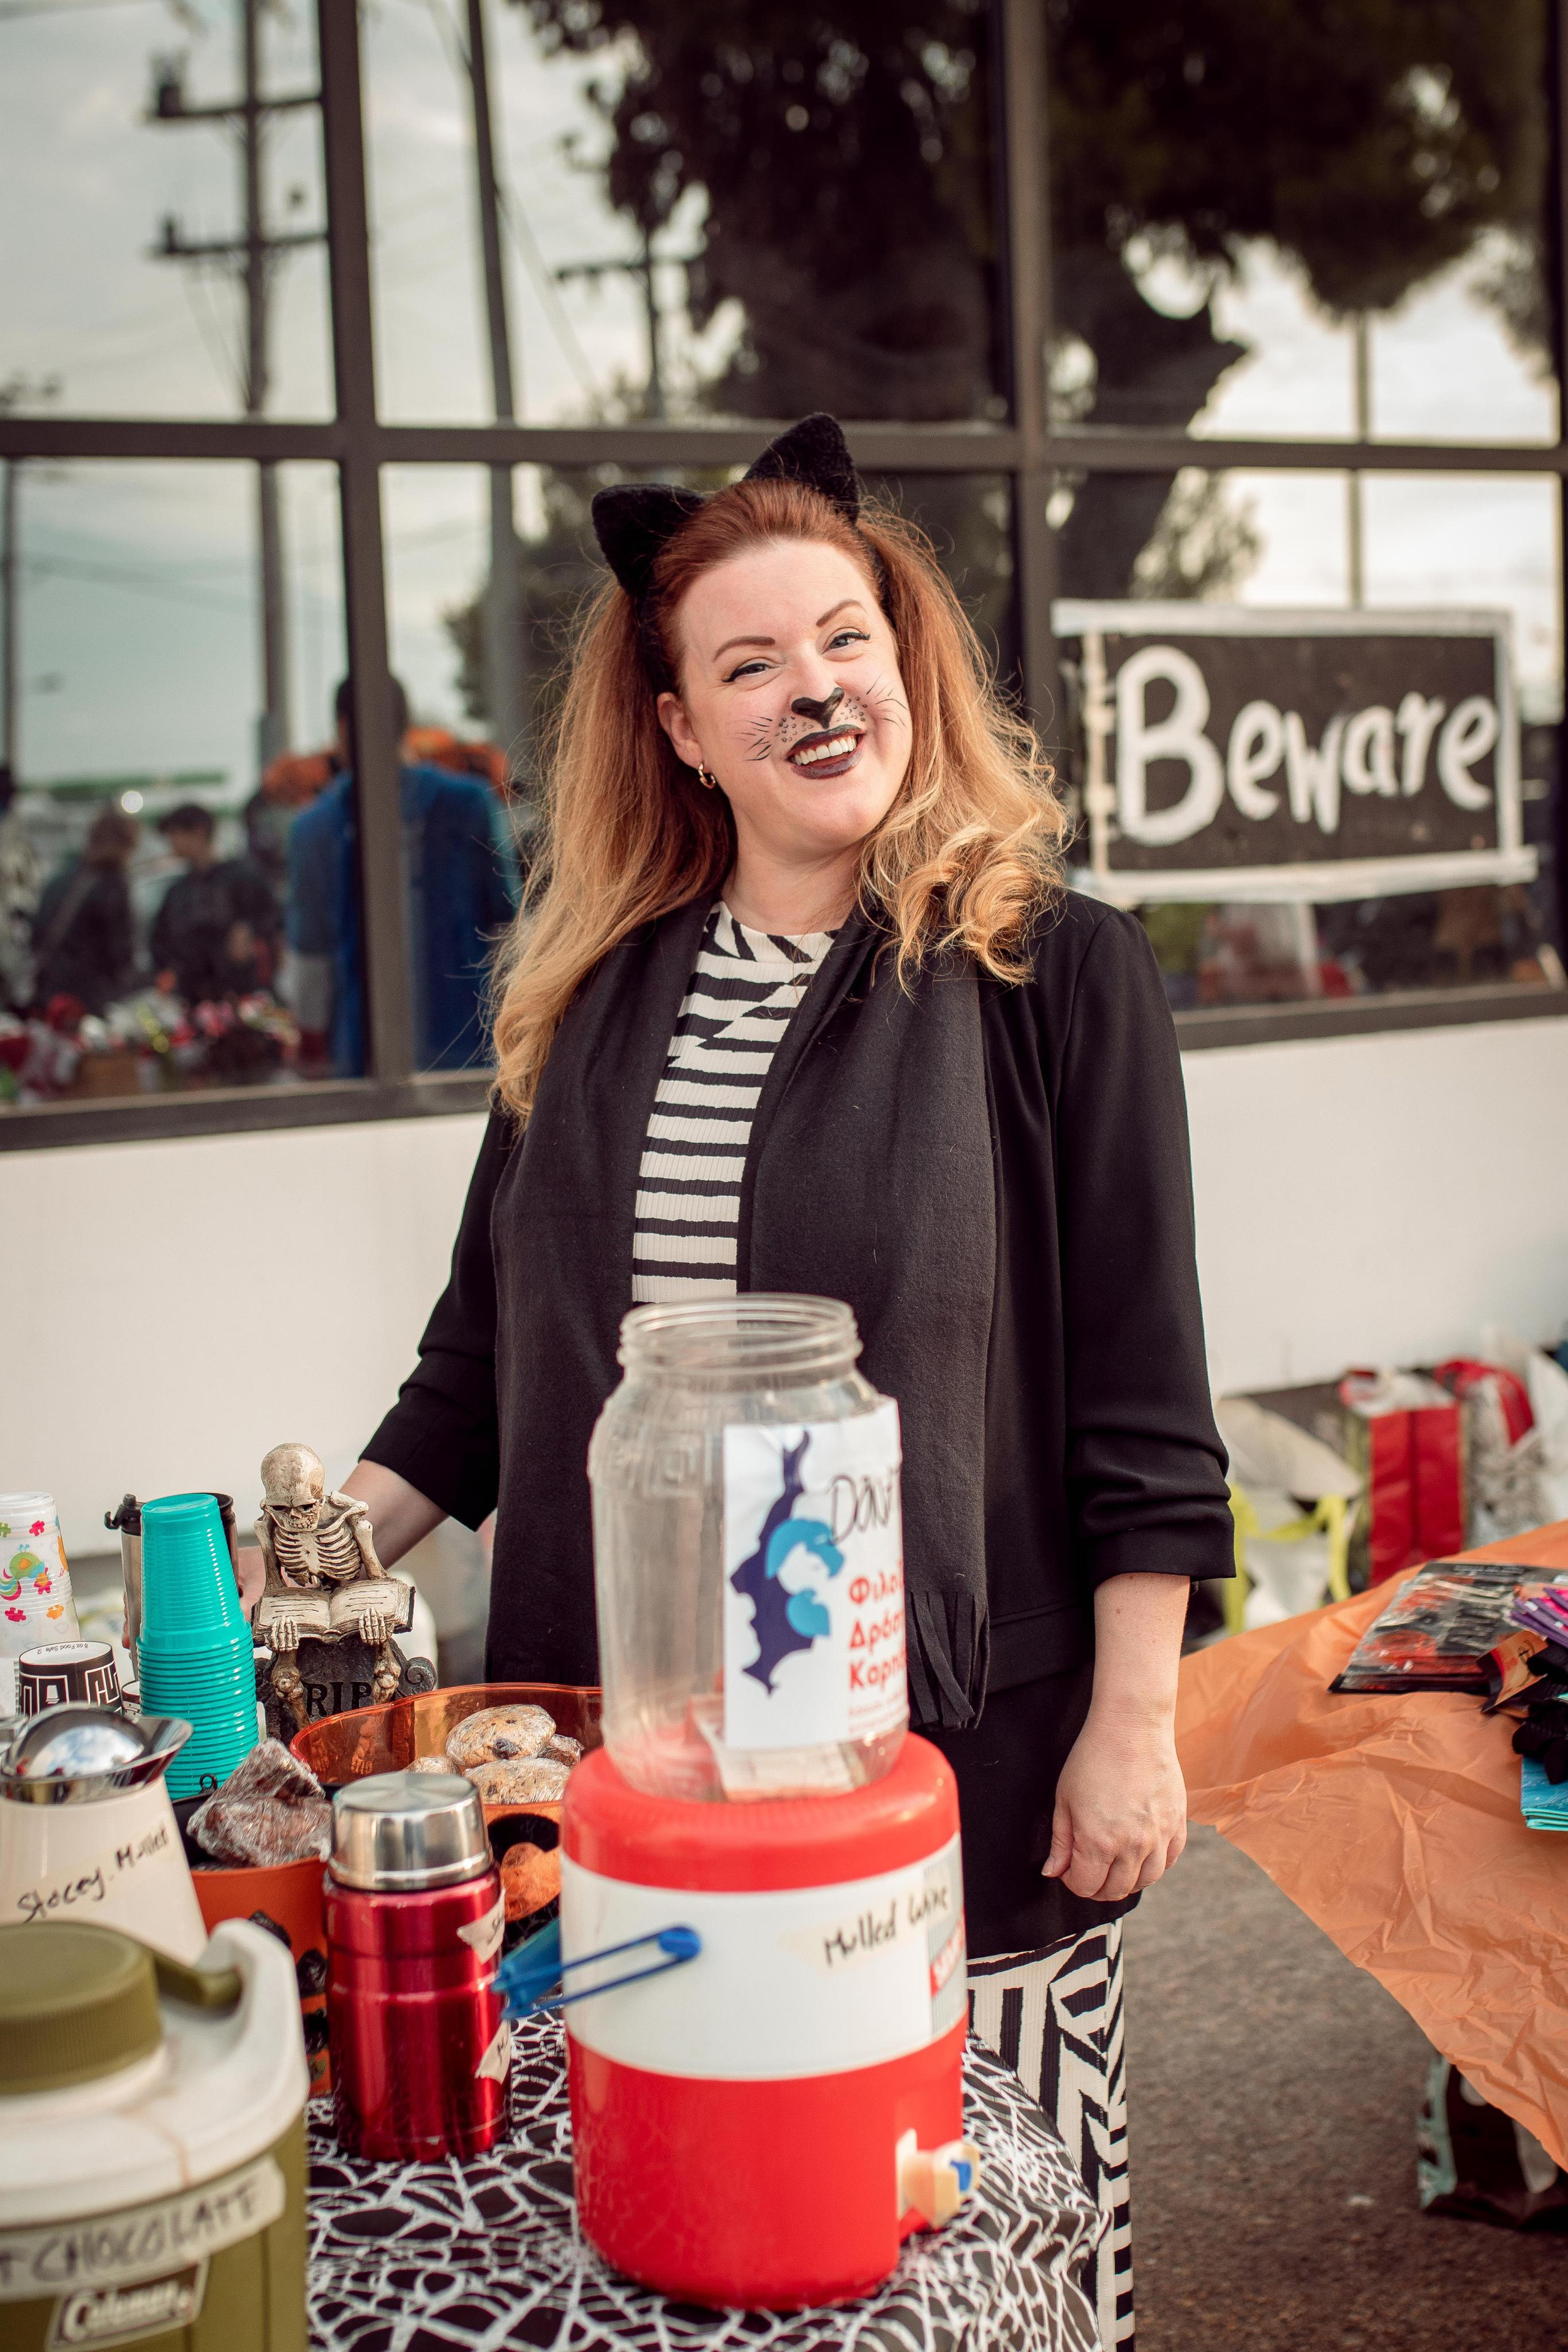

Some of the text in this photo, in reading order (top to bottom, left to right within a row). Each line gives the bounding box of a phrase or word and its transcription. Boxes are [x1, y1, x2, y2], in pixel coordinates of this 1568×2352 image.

[1116, 644, 1499, 847] Beware
[304, 1681, 372, 1717] RIP
[823, 1898, 897, 1967] Mulled
